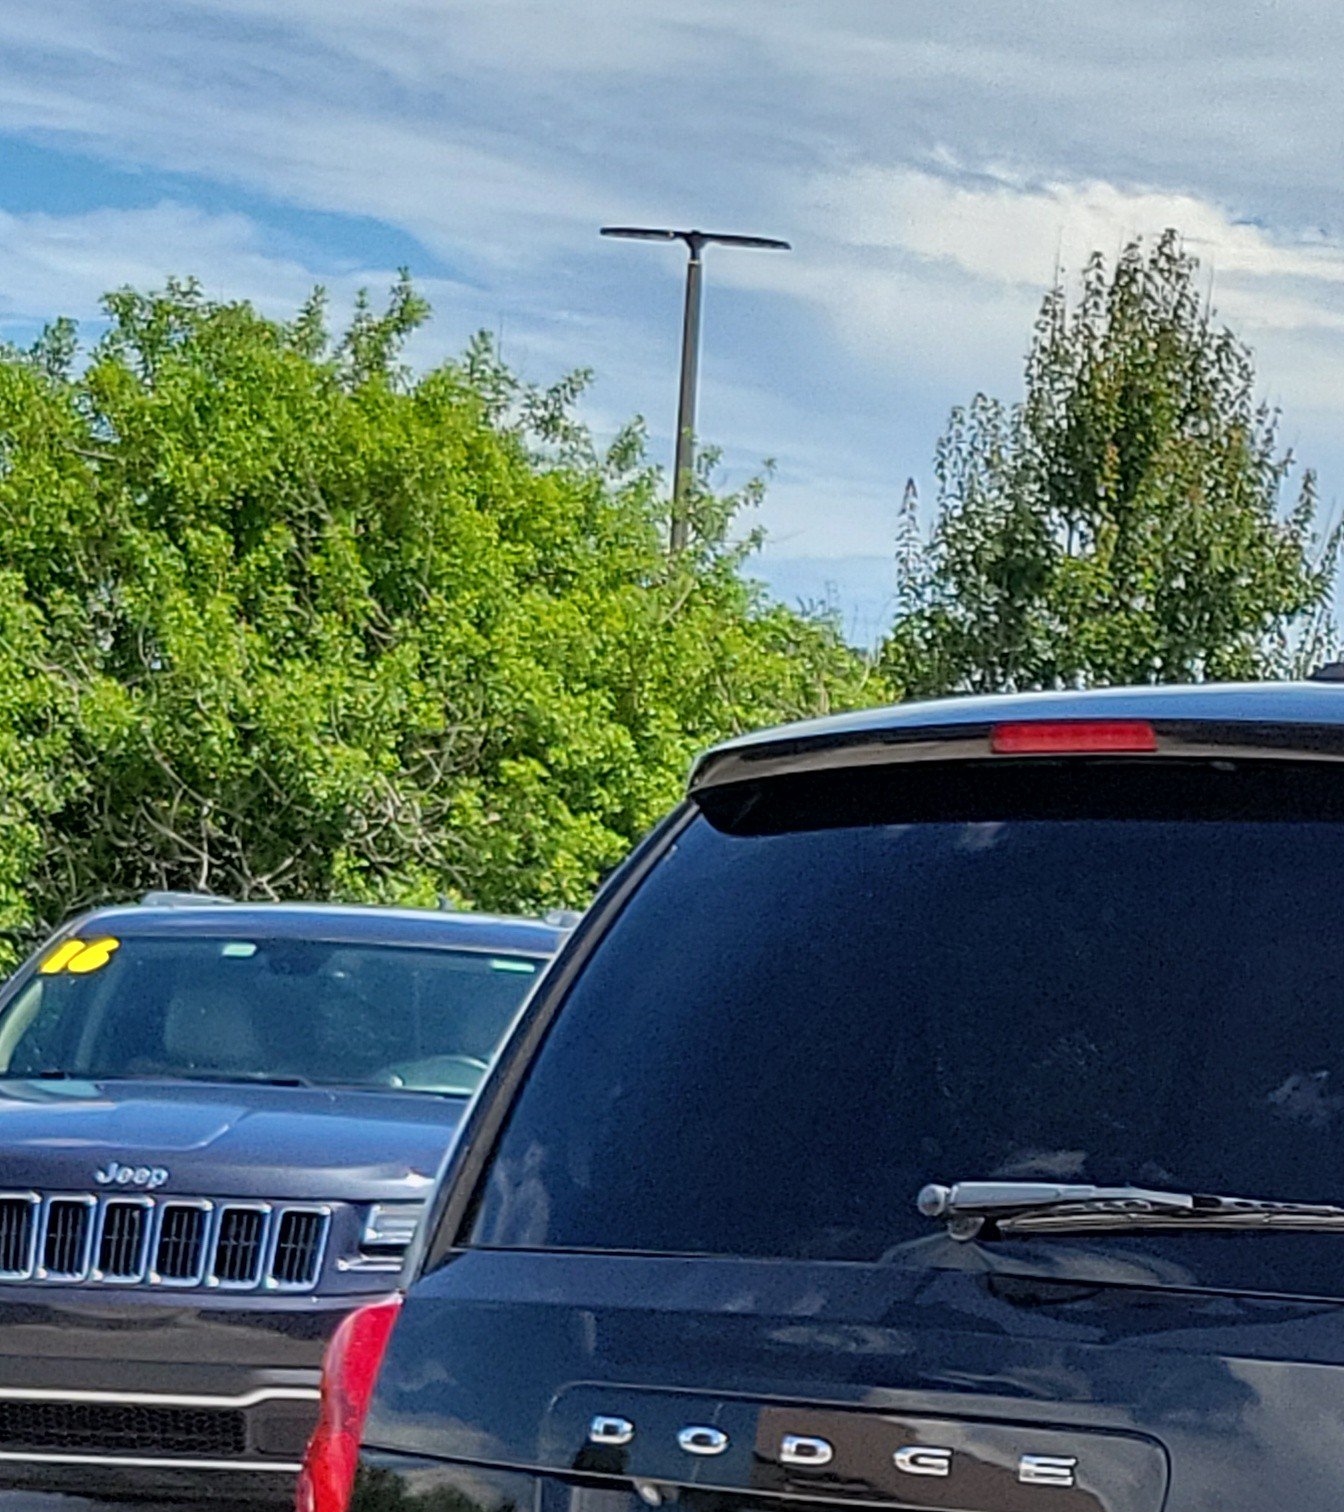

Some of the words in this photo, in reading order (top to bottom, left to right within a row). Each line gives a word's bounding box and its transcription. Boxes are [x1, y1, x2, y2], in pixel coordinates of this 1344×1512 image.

[41, 938, 120, 974] 16
[95, 1162, 169, 1188] Jeep
[590, 1415, 1077, 1486] DODGE
